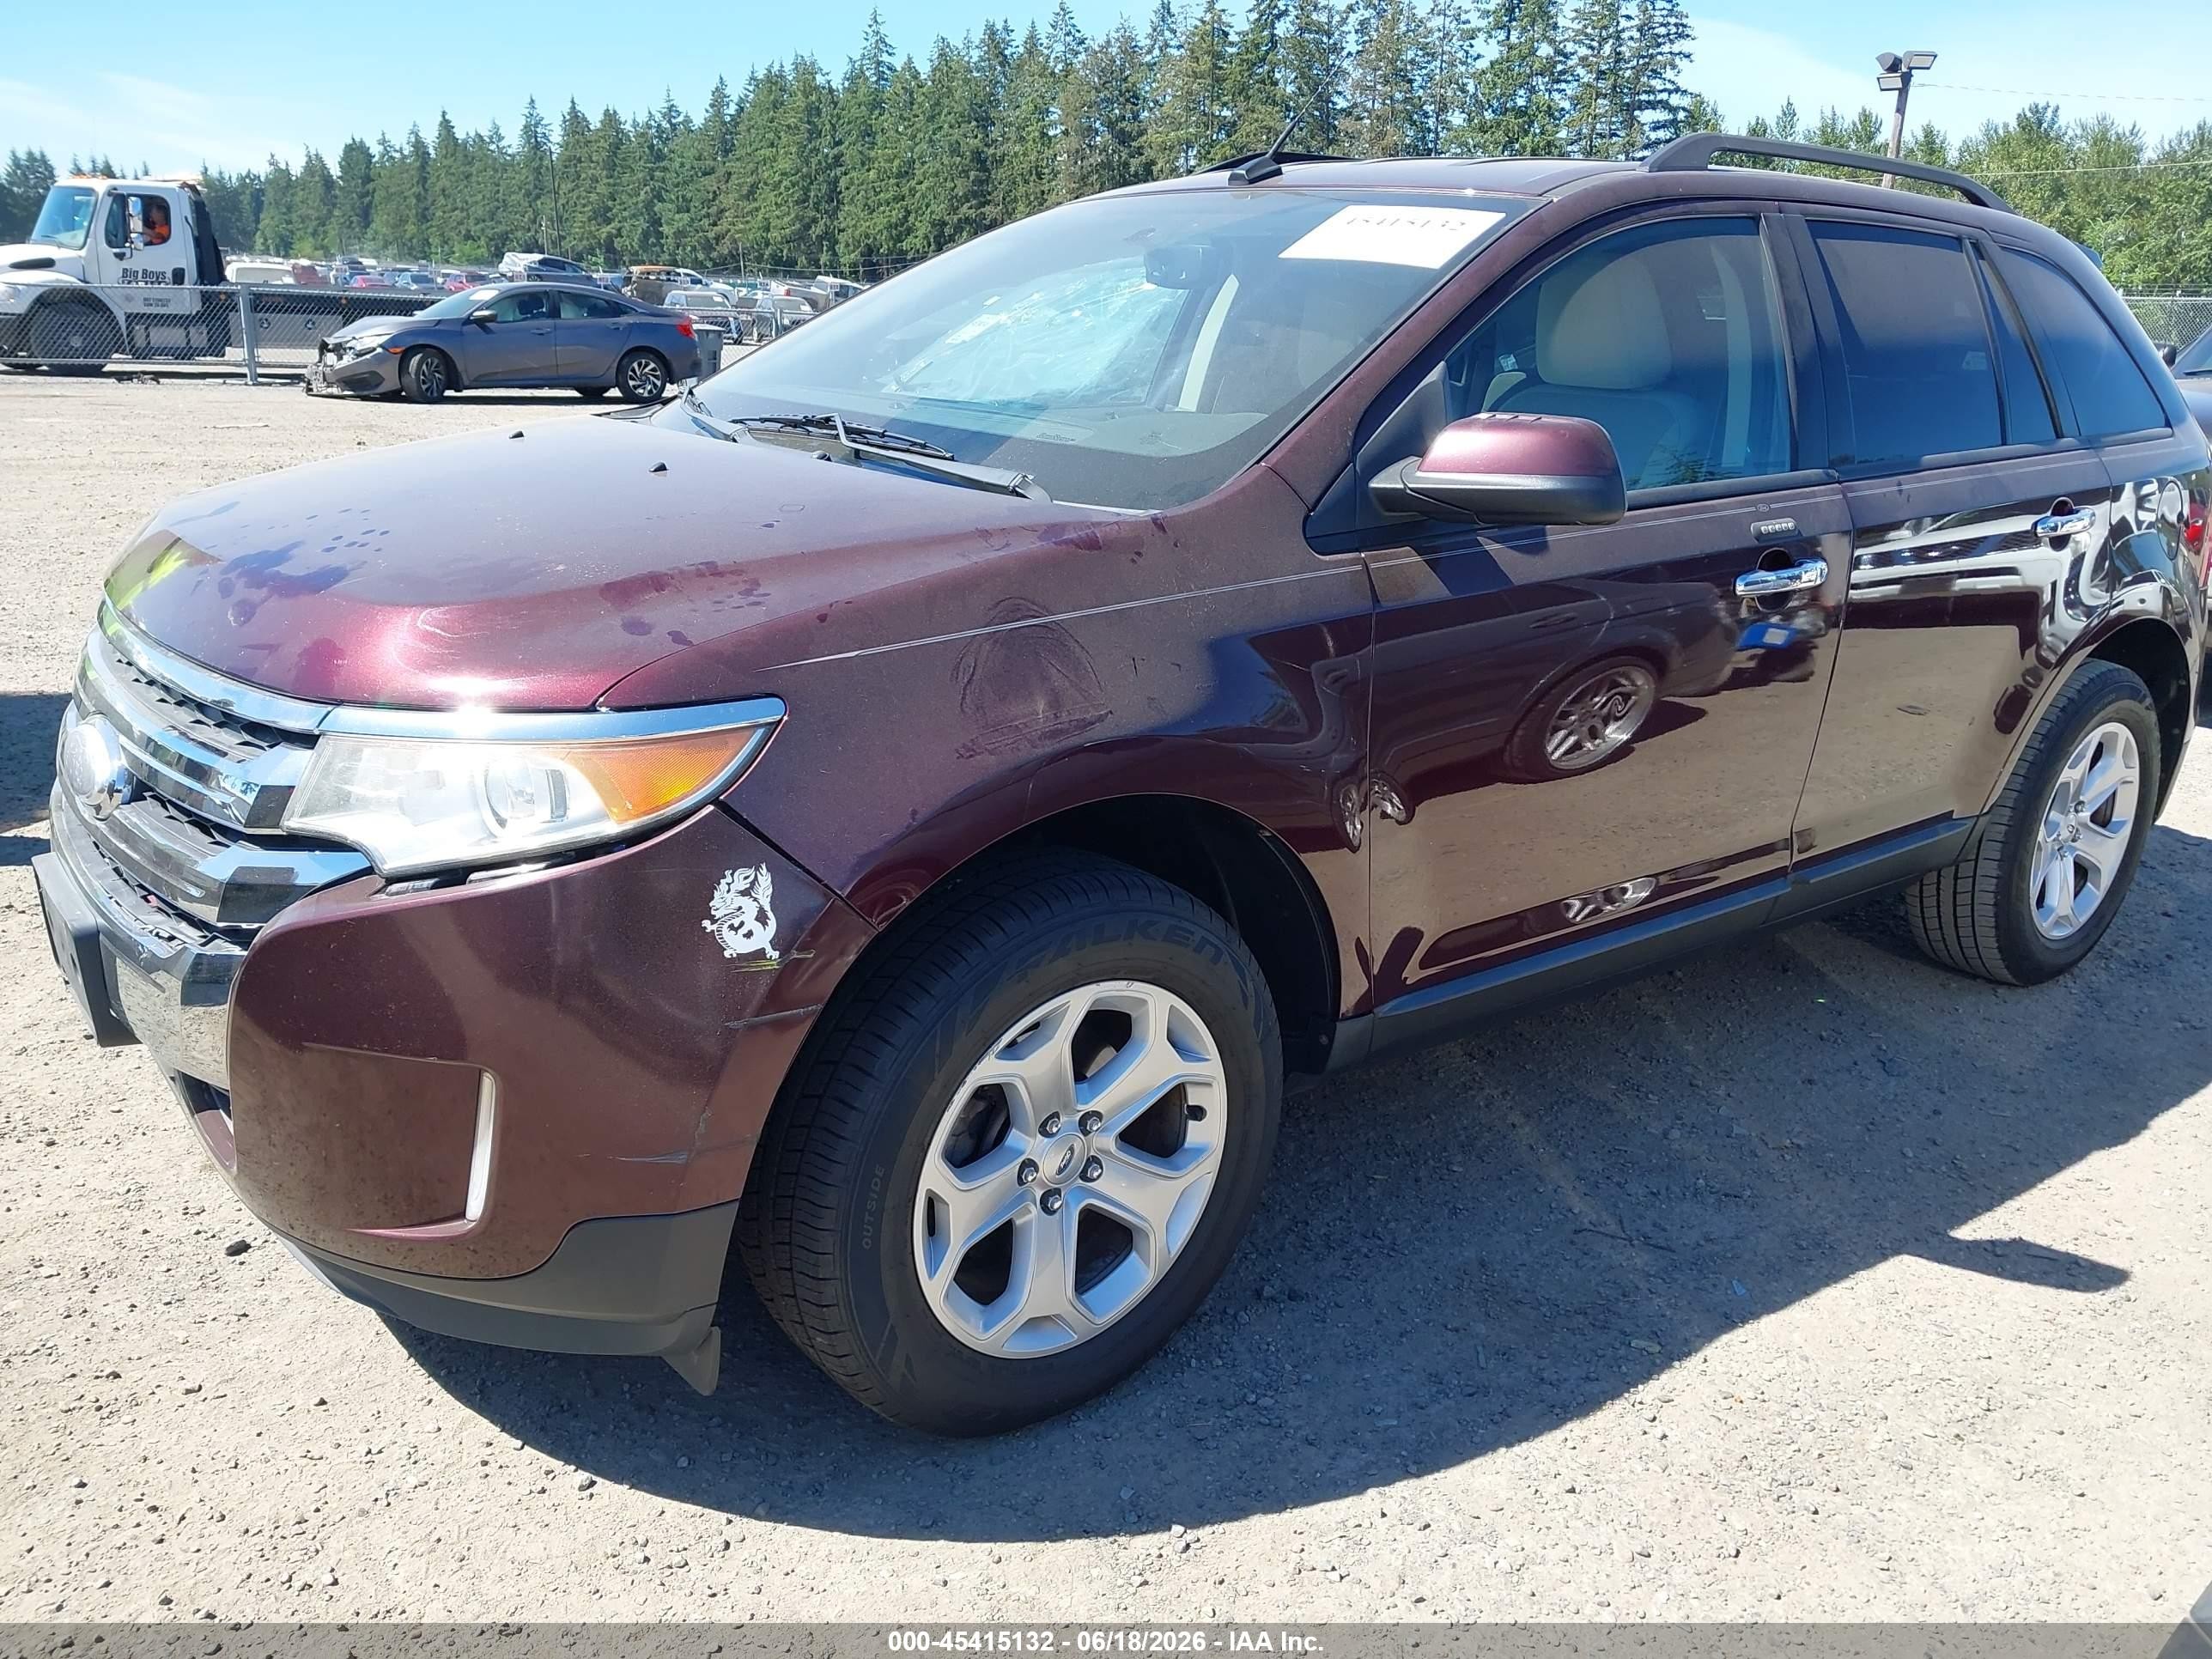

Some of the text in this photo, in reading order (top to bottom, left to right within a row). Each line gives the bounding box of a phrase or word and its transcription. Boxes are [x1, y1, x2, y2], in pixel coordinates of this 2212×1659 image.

[122, 268, 167, 281] Big Boys
[862, 1164, 885, 1249] OUTSIDE
